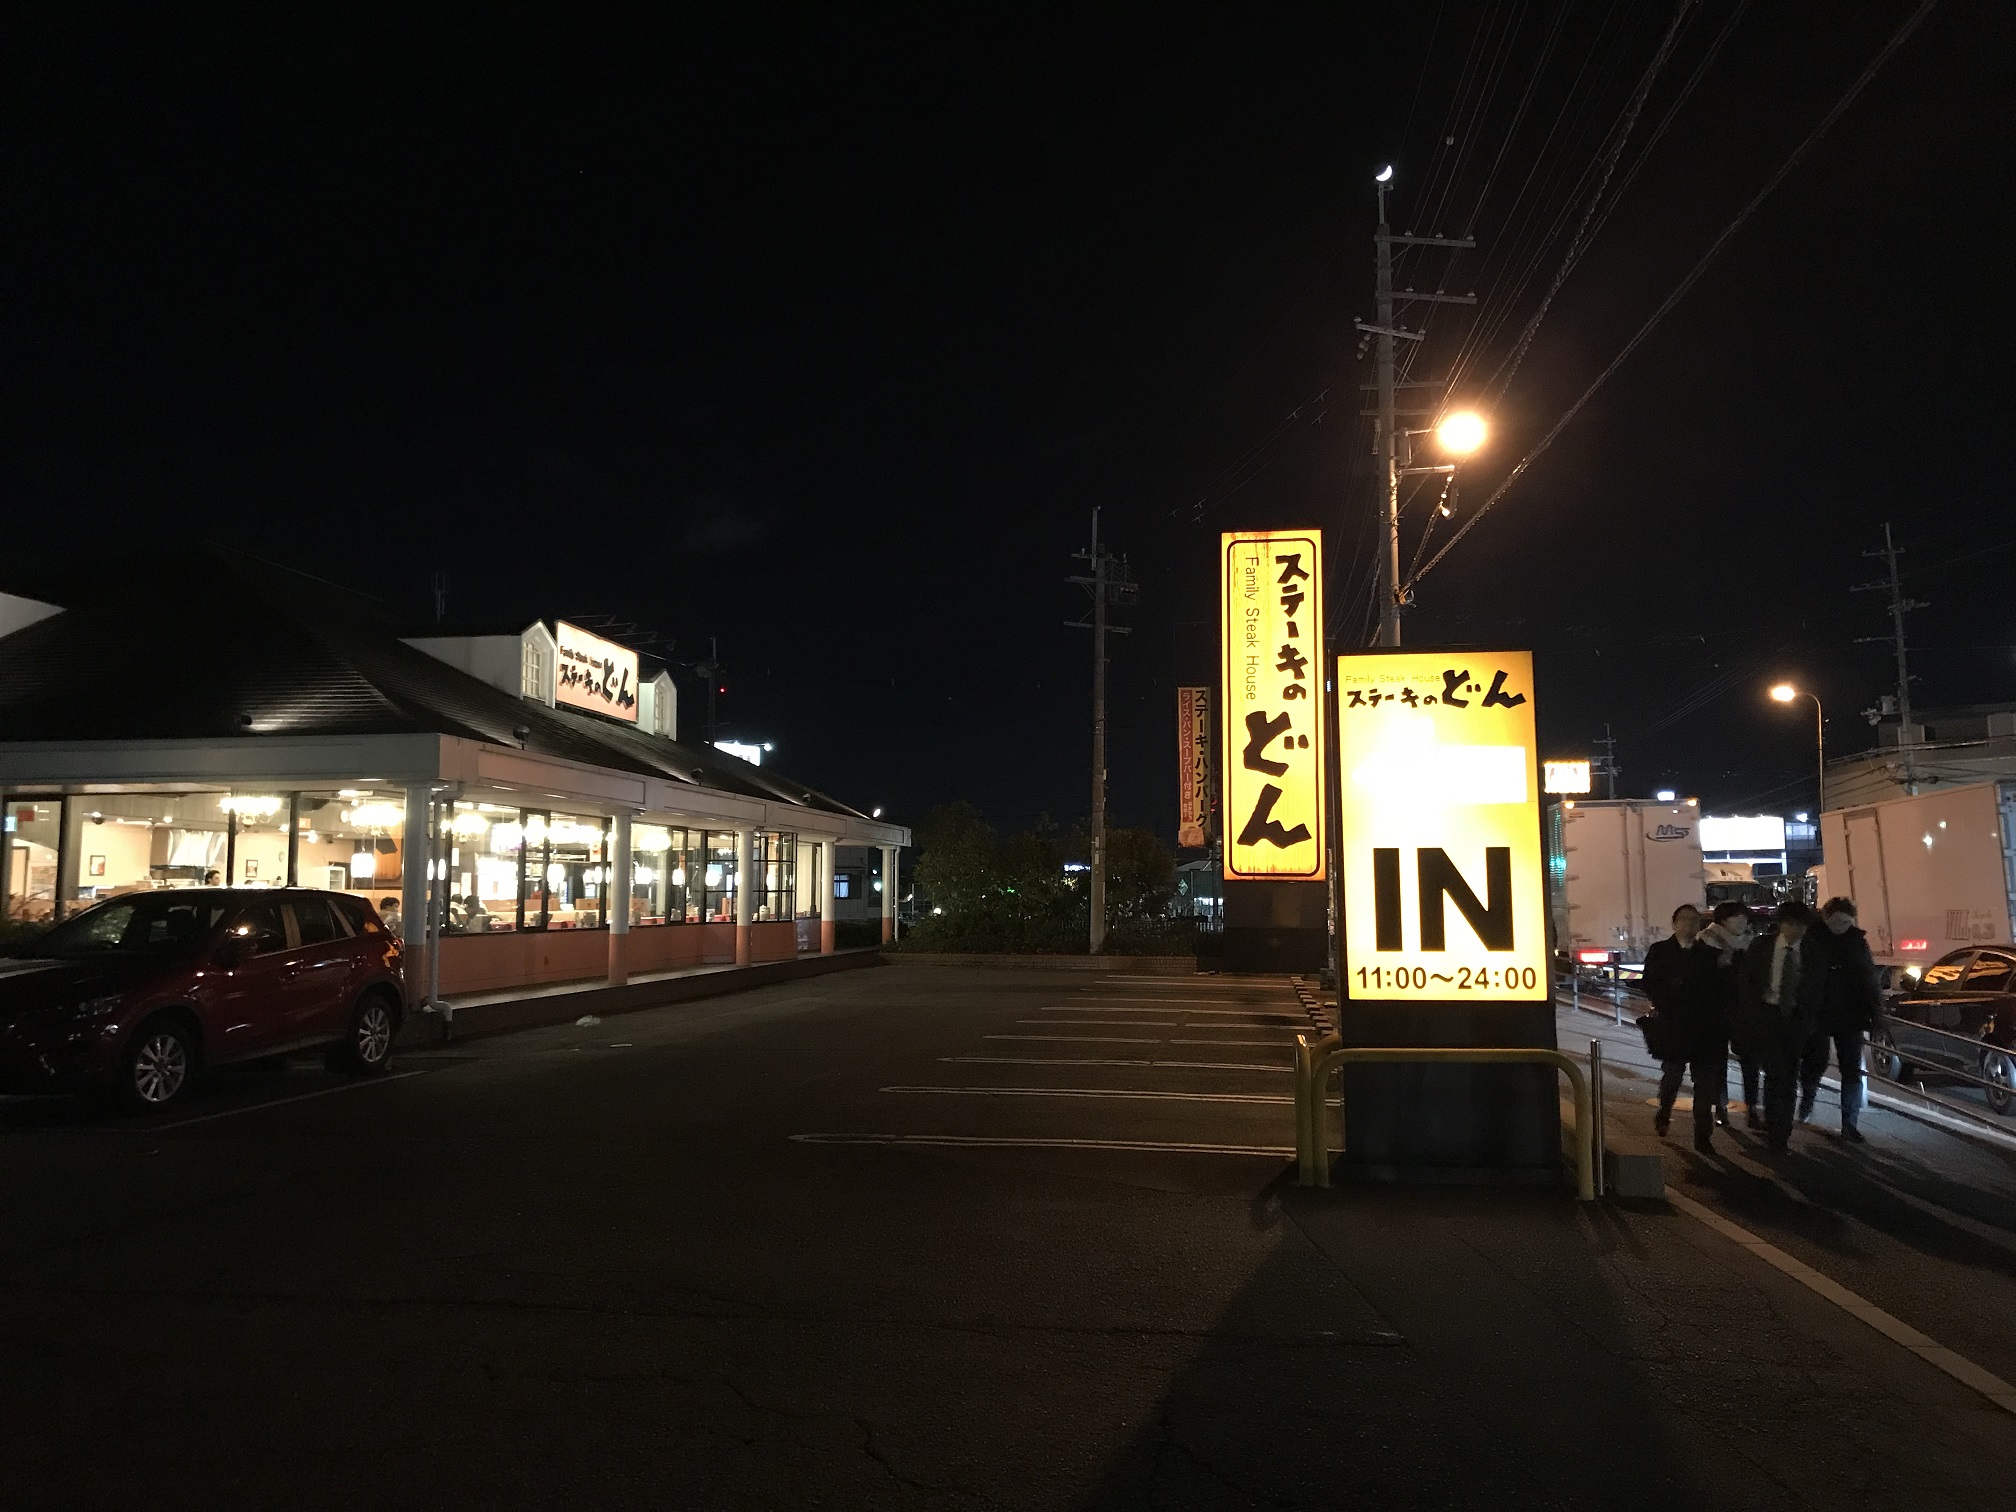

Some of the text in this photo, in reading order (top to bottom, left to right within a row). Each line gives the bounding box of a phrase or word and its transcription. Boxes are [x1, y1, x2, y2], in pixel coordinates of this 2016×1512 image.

[1244, 557, 1260, 700] Family Steak House
[1346, 674, 1440, 685] Family Steak House
[1237, 553, 1312, 848] ステーキのどん
[1346, 669, 1527, 709] ステーキのどん
[1373, 847, 1515, 952] IN
